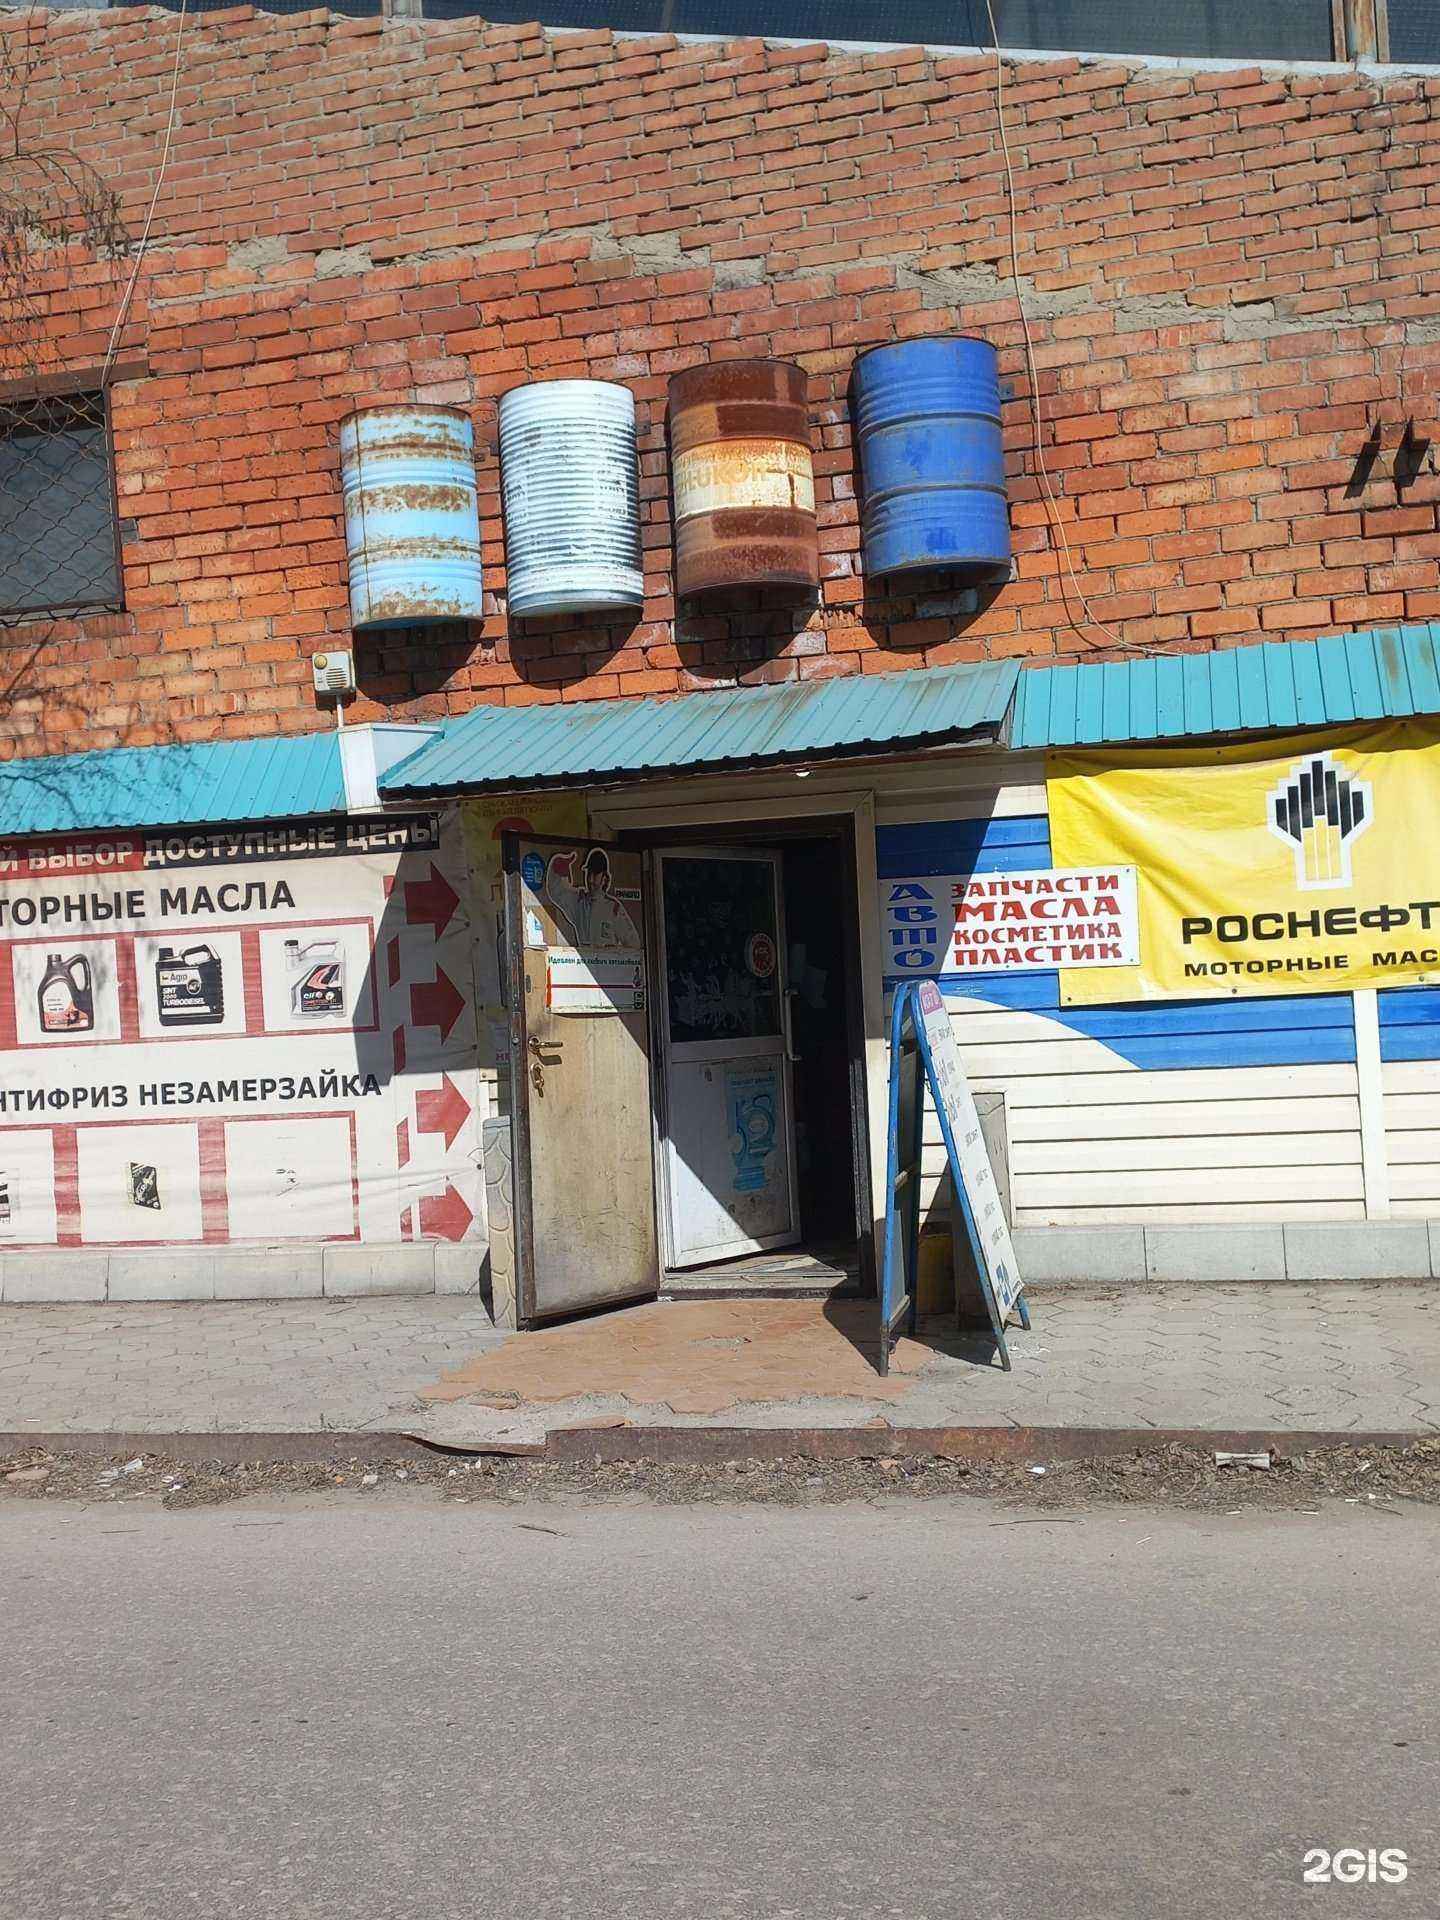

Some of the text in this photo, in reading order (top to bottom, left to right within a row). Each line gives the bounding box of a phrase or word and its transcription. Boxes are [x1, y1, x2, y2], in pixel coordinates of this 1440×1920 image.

[27, 841, 133, 870] ВЫБОР
[143, 826, 336, 866] ДОСТУПНЫЕ
[346, 818, 438, 850] ЦЕНЫ
[160, 880, 296, 916] МАСЛА
[951, 875, 1119, 898] ЗАПЧАСТИ
[952, 896, 1121, 923] МАСЛА
[1182, 901, 1440, 944] РОСНЕФТ
[952, 922, 1122, 945] КОСМЕТИКА
[954, 943, 1123, 966] ПЛАСТИК
[1184, 949, 1438, 977] МОТОРНЫЕ МАС
[139, 1068, 382, 1106] НЕЗАМЕРЗАЙКА
